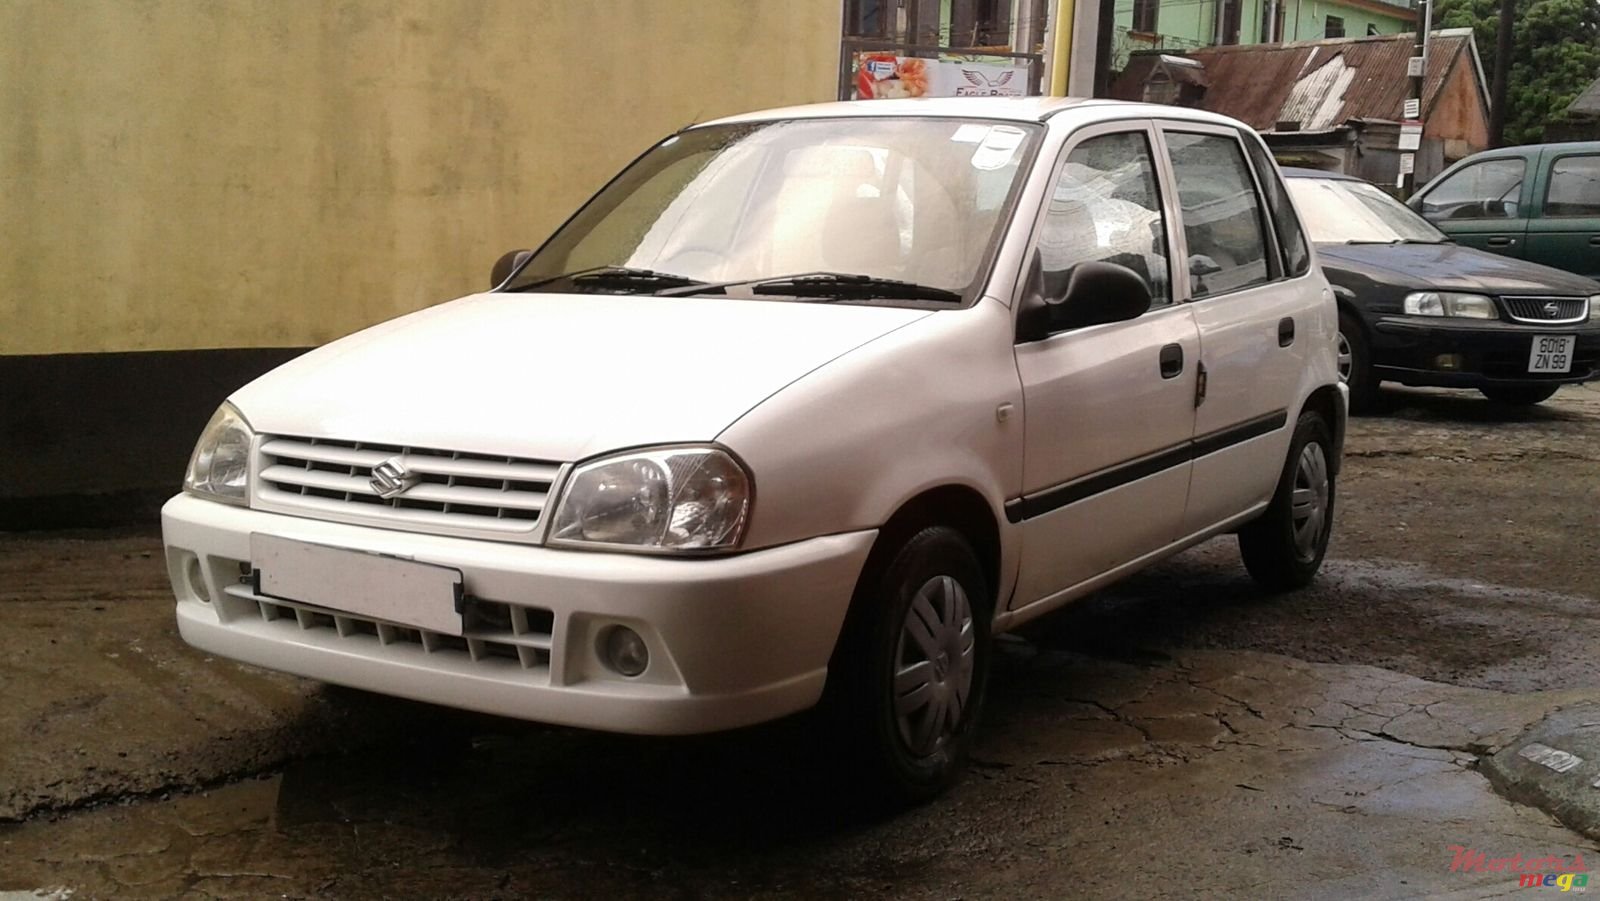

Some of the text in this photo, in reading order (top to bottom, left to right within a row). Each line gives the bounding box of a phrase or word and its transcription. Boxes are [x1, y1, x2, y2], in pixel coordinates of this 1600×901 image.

[1540, 338, 1566, 353] 6018
[1534, 354, 1567, 369] ZN 99
